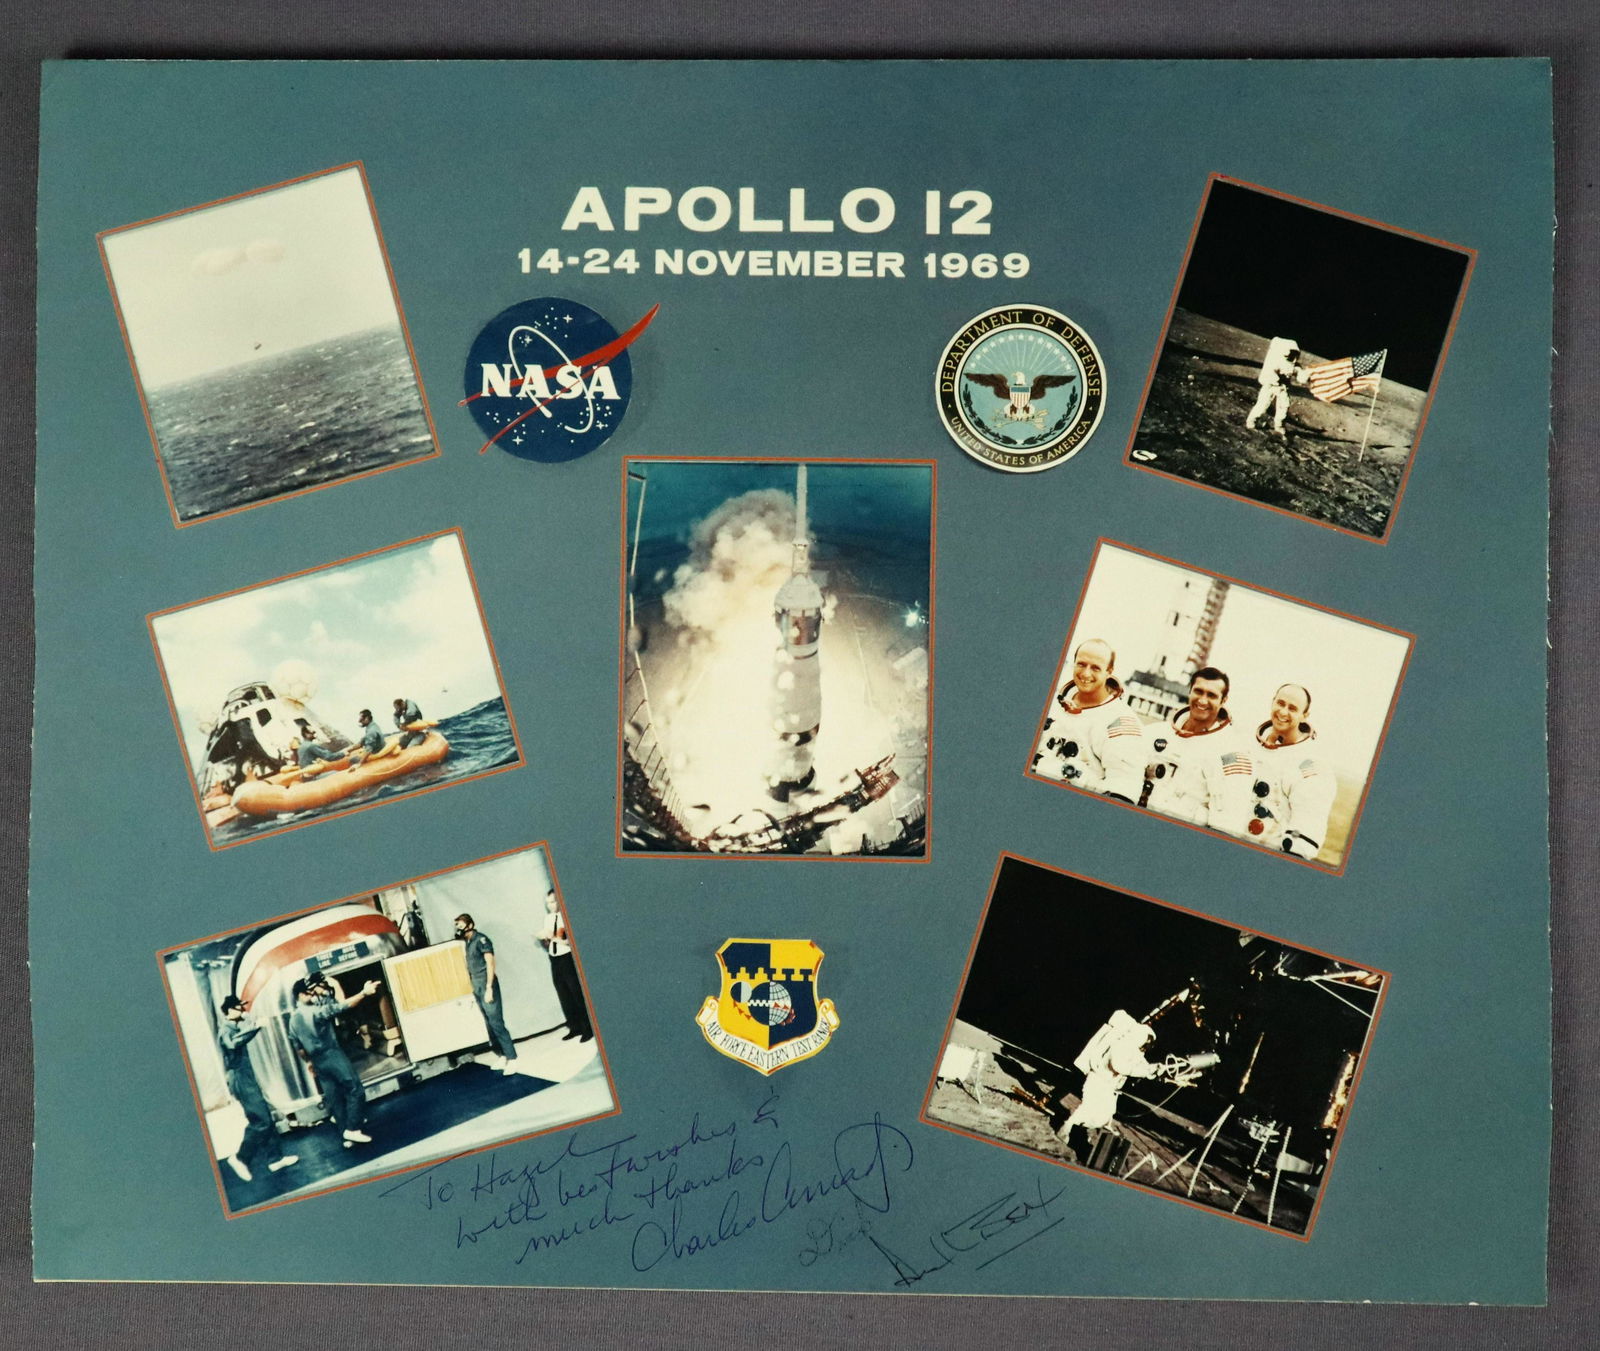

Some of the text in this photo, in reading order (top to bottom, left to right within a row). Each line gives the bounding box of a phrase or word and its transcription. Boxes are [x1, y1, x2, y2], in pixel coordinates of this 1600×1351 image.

[561, 186, 993, 235] APOLLO 12
[518, 248, 1030, 279] 14-24 NOVEMBER 1969
[942, 311, 1100, 396] DEPARTMENT OF DEFENSE
[481, 363, 621, 400] NASA
[951, 416, 1090, 465] UNITED STATES OF AMERICA
[707, 1021, 722, 1040] AIR
[720, 1034, 751, 1058] FORCE
[748, 1047, 790, 1069] EASTERN
[791, 1037, 812, 1057] TEST
